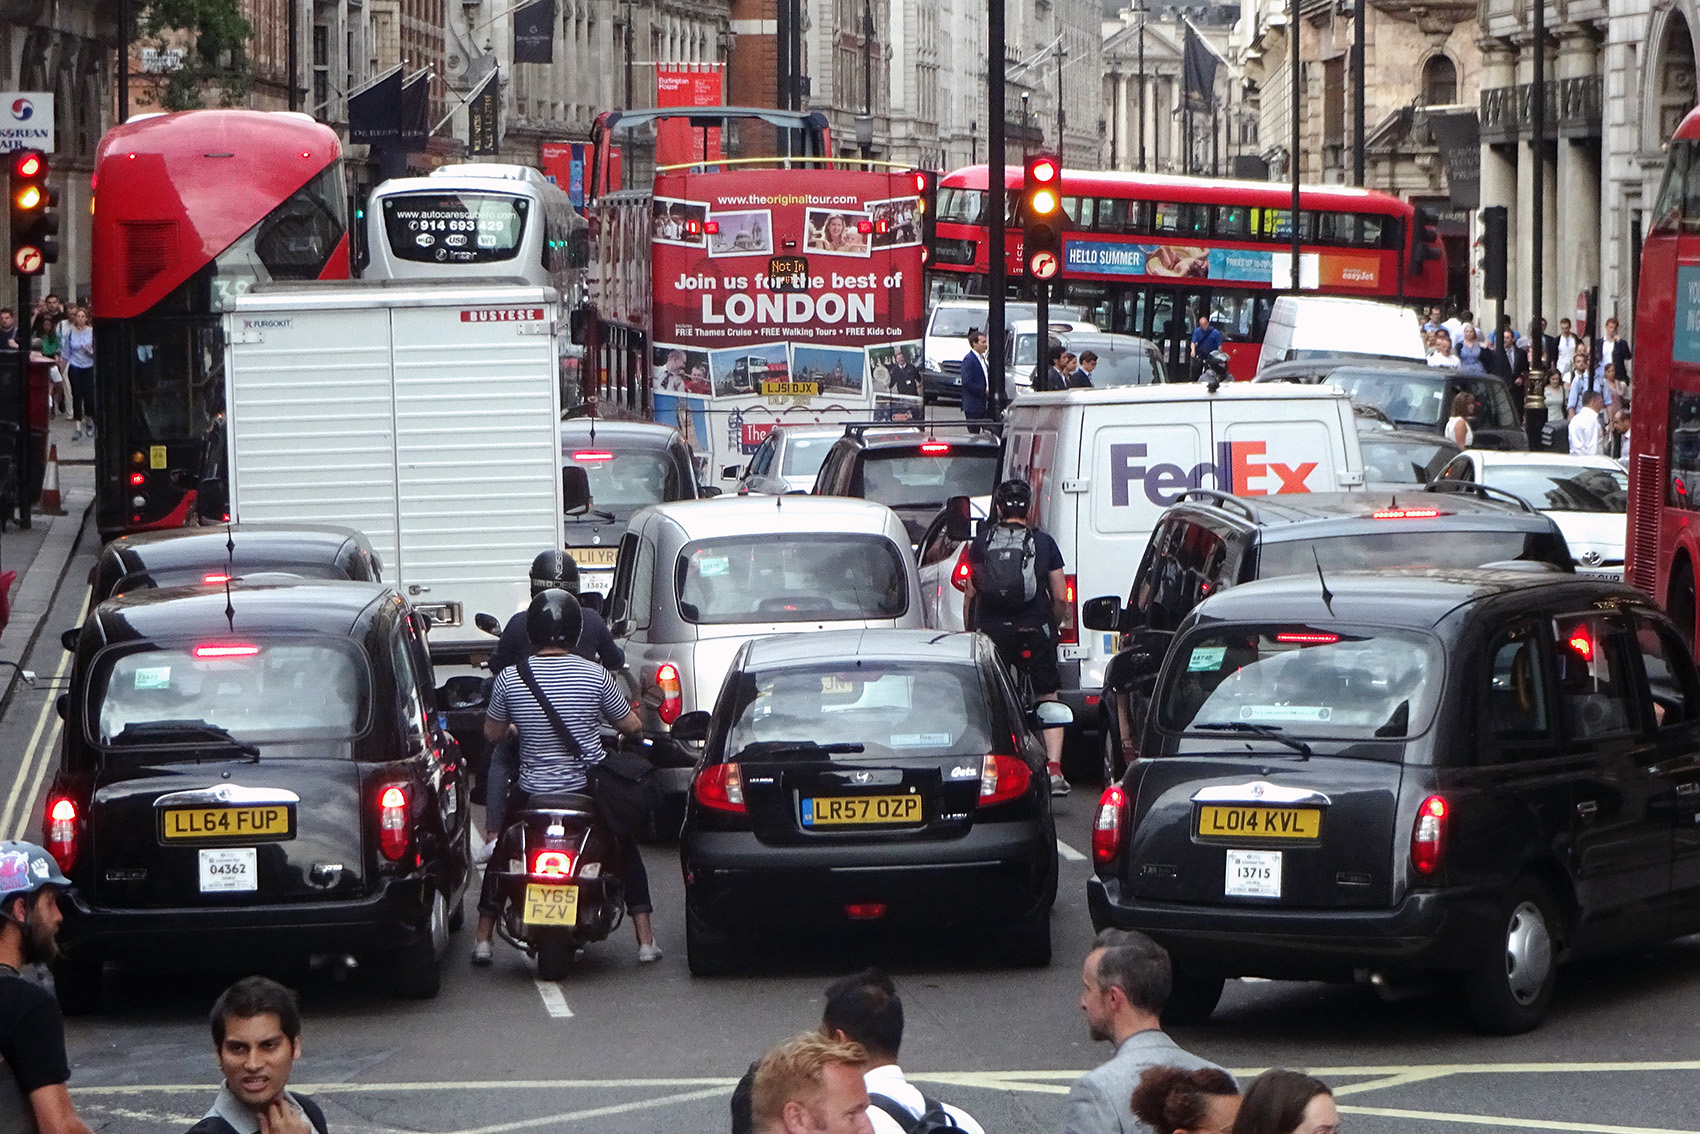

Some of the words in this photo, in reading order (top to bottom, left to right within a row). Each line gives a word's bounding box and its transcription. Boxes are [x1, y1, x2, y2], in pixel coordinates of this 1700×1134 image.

[0, 129, 48, 138] KOREAN
[0, 140, 22, 148] AIR
[717, 194, 858, 206] www.theoriginaltour.com
[420, 221, 446, 231] 914
[449, 221, 475, 231] 693
[479, 221, 504, 231] 429
[448, 236, 468, 244] USB
[1069, 249, 1098, 264] HELLO
[1099, 251, 1140, 265] SUMMER
[773, 261, 790, 273] Not
[794, 261, 805, 273] In
[674, 273, 717, 290] Join
[724, 276, 748, 290] us
[754, 273, 786, 289] for
[791, 272, 824, 289] the
[832, 272, 877, 288] best
[883, 272, 903, 288] of
[1341, 270, 1374, 281] easyJet
[702, 292, 875, 324] LONDON
[470, 309, 536, 322] BUSTESE
[253, 320, 291, 328] FURGOKIT
[675, 328, 693, 337] FREE
[695, 328, 725, 337] Thames
[727, 328, 752, 337] Cruise
[761, 328, 780, 337] FREE
[782, 327, 814, 337] Walking
[815, 327, 837, 336] Tours
[845, 327, 865, 336] FREE
[866, 327, 884, 336] Kids
[886, 327, 903, 336] Cub
[767, 384, 790, 393] LJ51
[792, 383, 812, 393] DJX
[747, 425, 767, 440] The
[1110, 440, 1320, 507] FedEx
[816, 801, 870, 820] LR57
[877, 799, 918, 819] OZP
[175, 811, 230, 833] LL64
[237, 809, 279, 831] FUP
[1213, 809, 1259, 831] LO14
[1264, 811, 1305, 833] KVL
[210, 863, 247, 875] 04362
[1237, 867, 1271, 879] 13715
[528, 887, 576, 904] LY65
[531, 903, 568, 919] FZV
